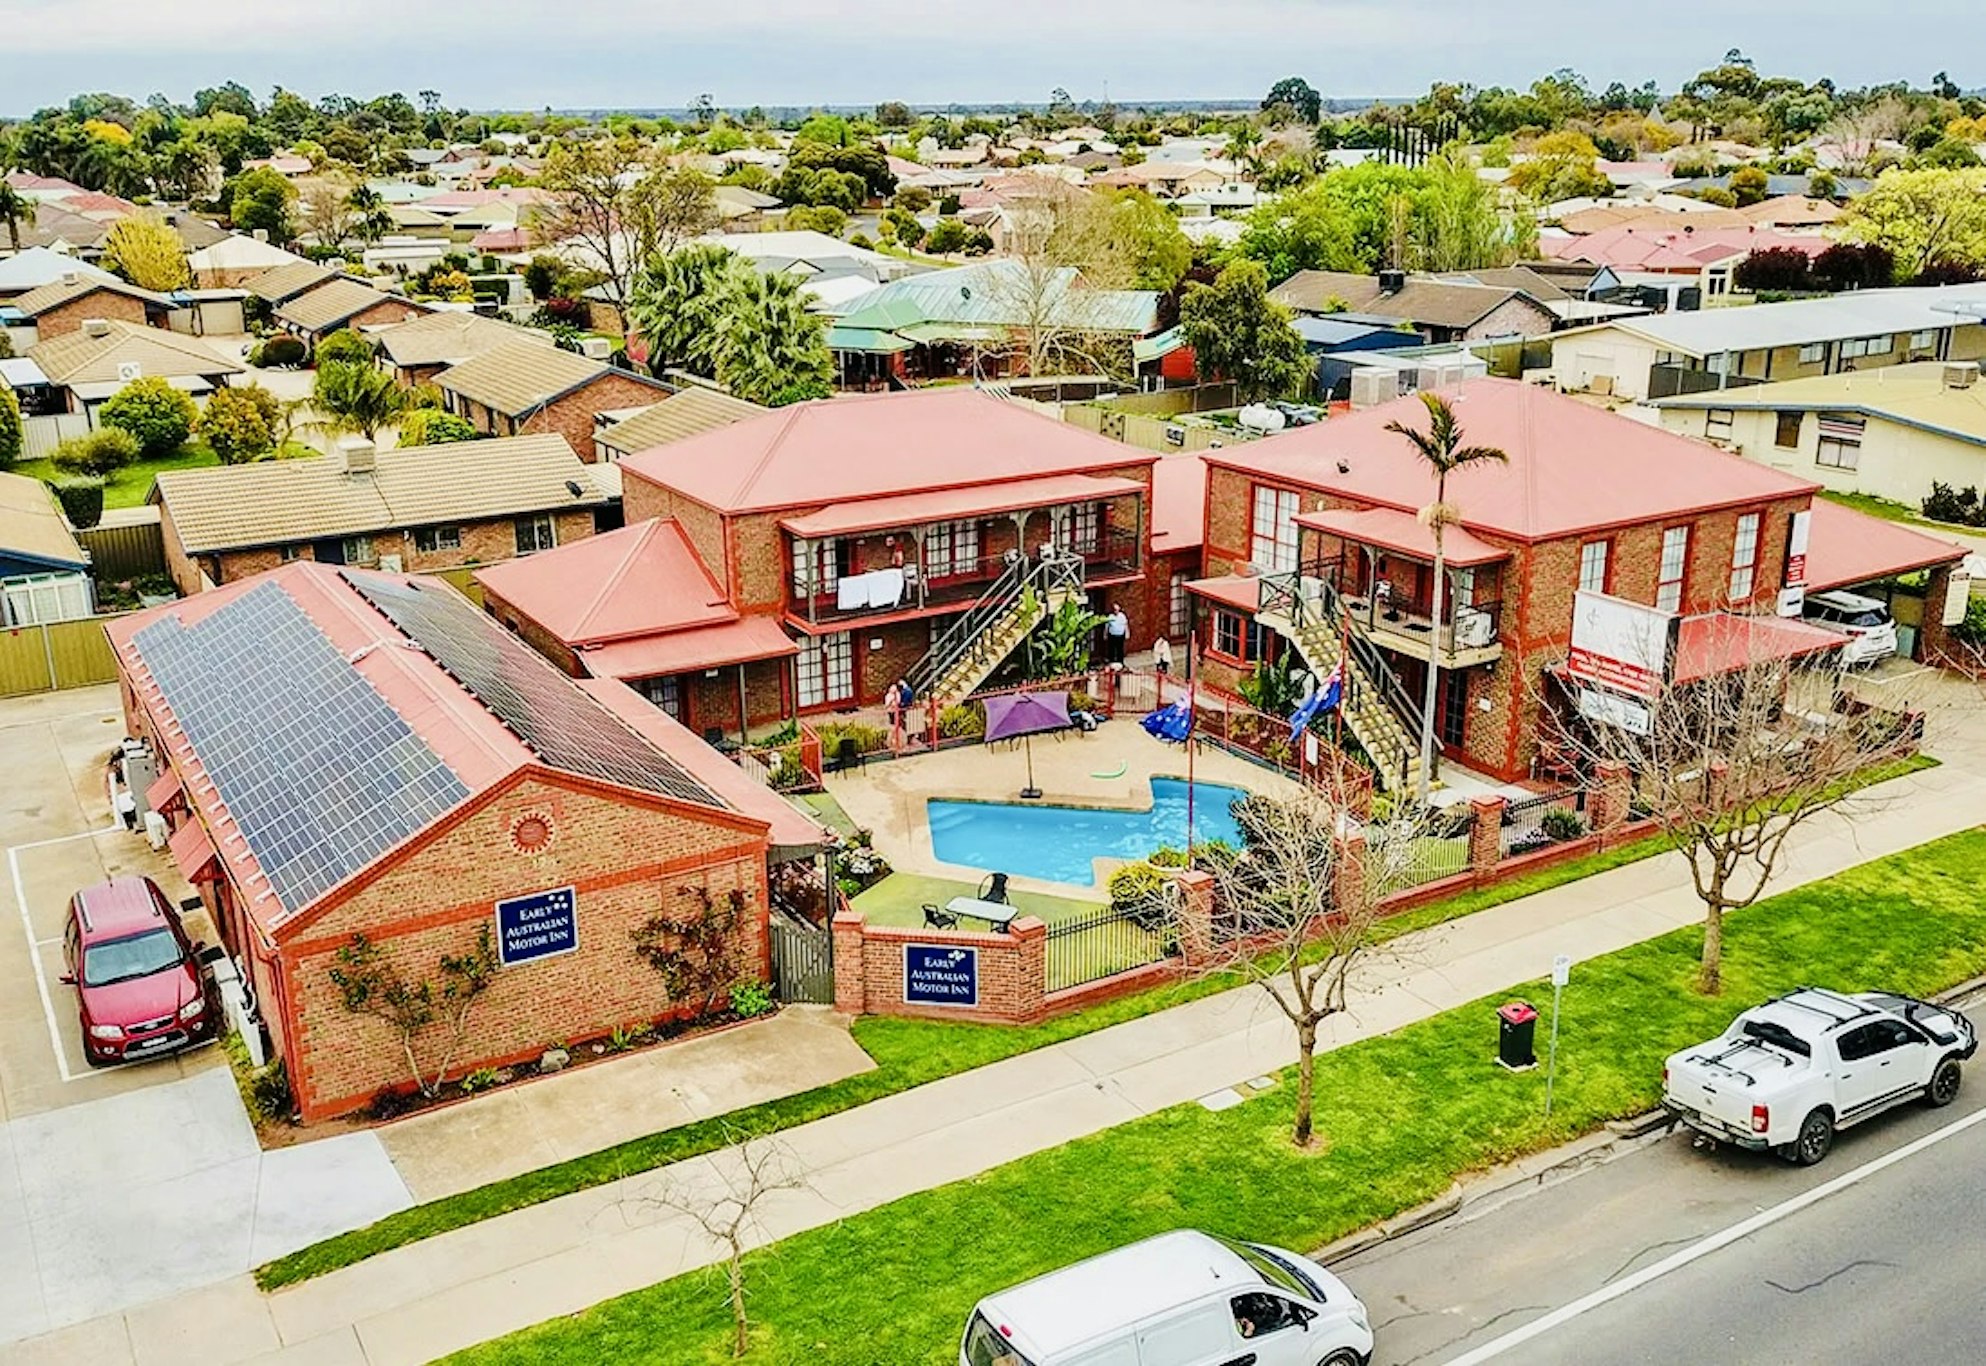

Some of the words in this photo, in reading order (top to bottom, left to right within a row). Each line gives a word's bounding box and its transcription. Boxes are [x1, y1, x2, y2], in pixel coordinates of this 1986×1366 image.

[520, 905, 552, 921] EARLY
[506, 915, 568, 938] AUSTRALIAN
[508, 935, 548, 952] MOTOR
[549, 929, 568, 942] INN
[924, 957, 956, 969] EARLY
[911, 969, 969, 982] AUSTRALIAN
[912, 981, 949, 993] MOTOR
